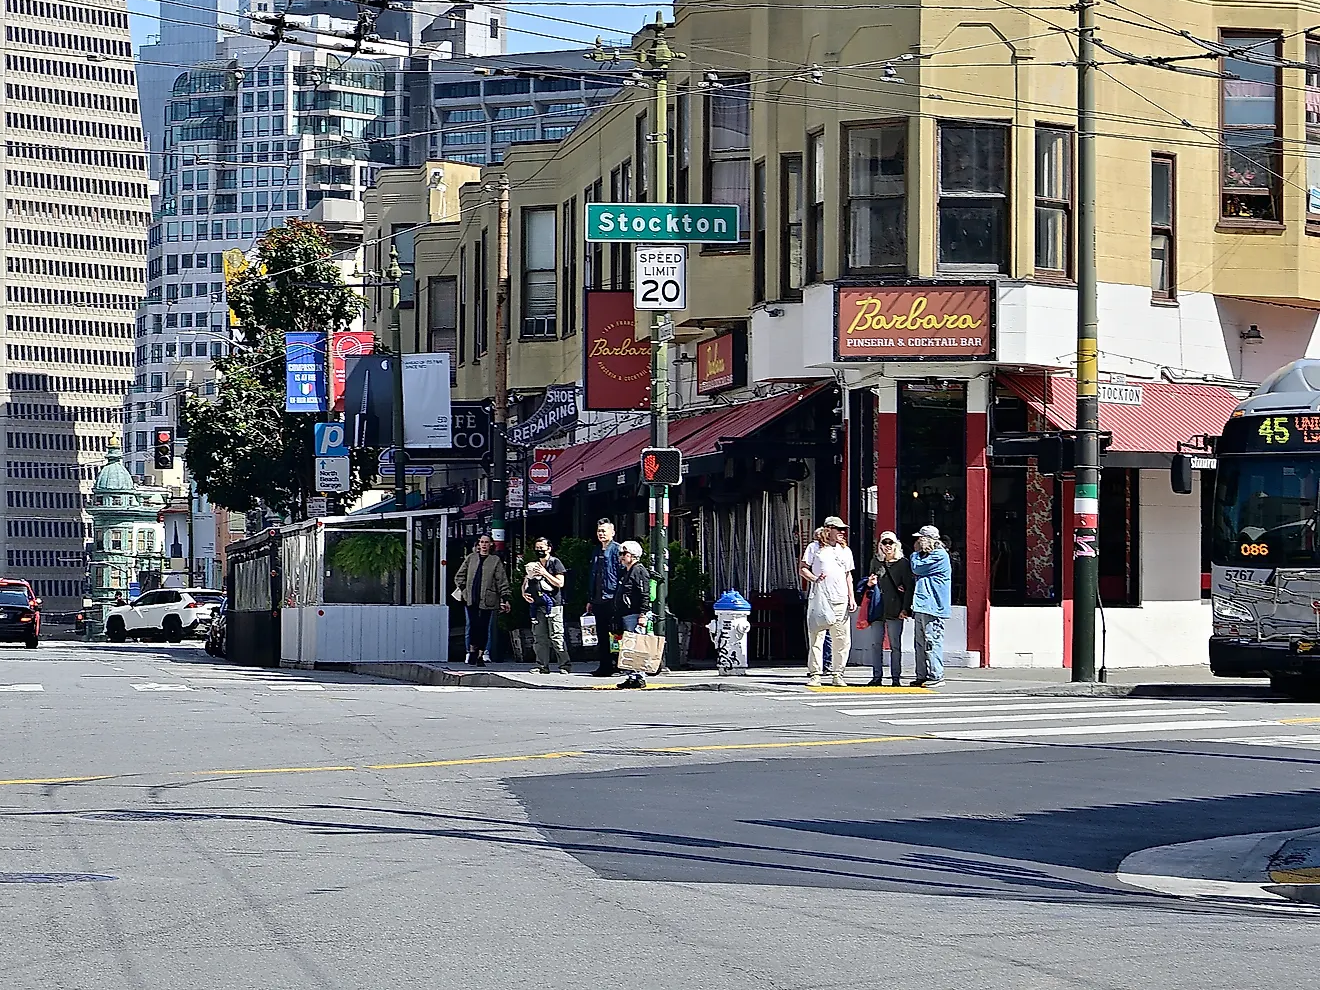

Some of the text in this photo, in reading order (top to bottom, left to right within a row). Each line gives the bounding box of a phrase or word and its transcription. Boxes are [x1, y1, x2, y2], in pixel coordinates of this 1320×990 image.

[598, 212, 728, 233] Stockton
[640, 253, 682, 263] SPEED
[644, 267, 677, 276] LIMIT
[641, 280, 680, 302] 20
[847, 296, 982, 335] Barbara
[846, 338, 982, 347] PINSERIA & COCKTAIL BAR
[547, 390, 574, 403] SHOE
[513, 403, 576, 441] REPAIRING
[1294, 416, 1320, 430] UNI
[1258, 417, 1290, 443] 45
[1240, 543, 1269, 556] 086
[1225, 569, 1255, 582] 5767
